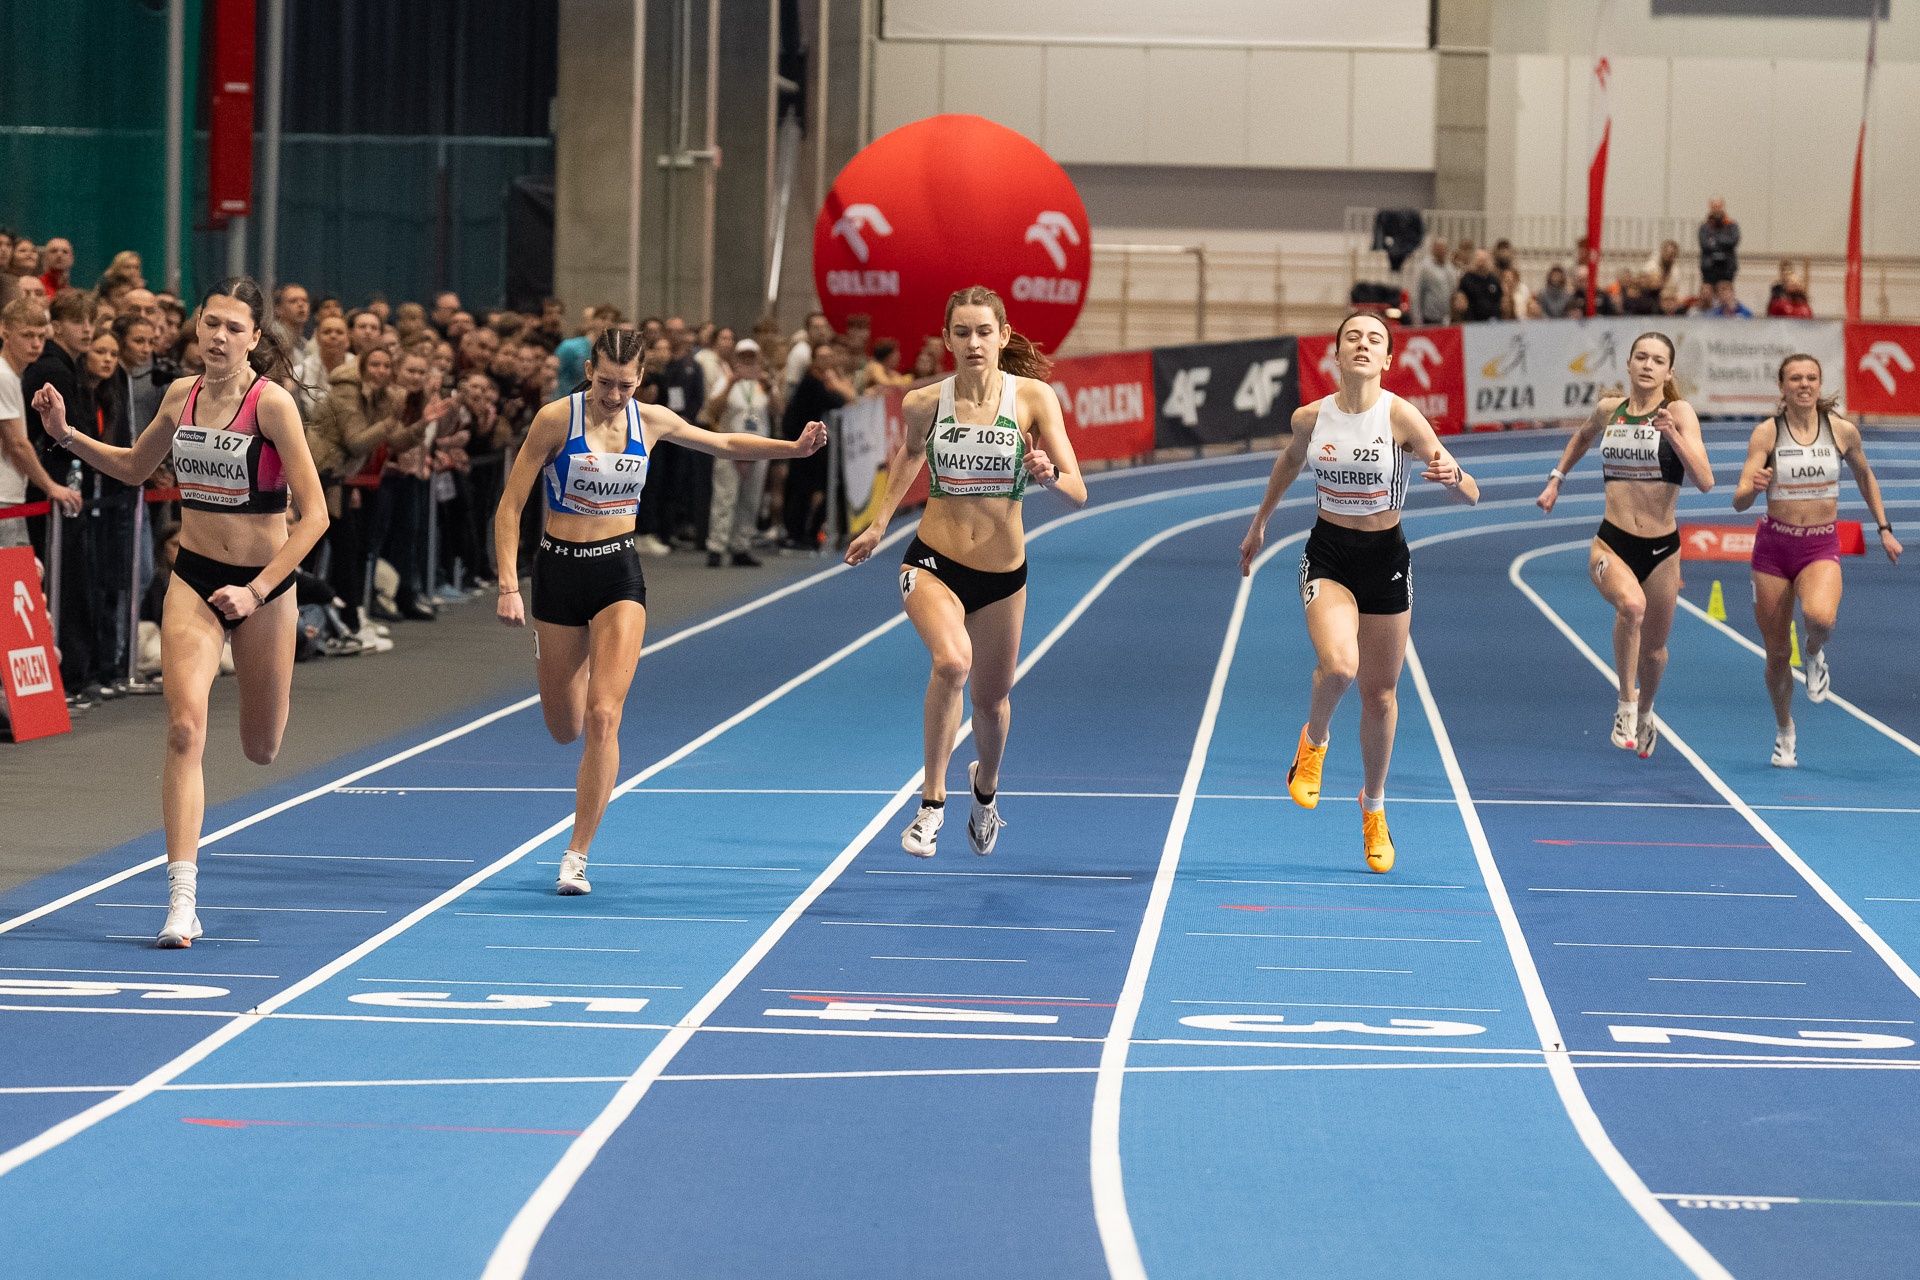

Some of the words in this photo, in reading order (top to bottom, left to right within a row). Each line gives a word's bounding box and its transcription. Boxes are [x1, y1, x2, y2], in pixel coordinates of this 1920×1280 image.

[826, 269, 900, 296] ORLEN
[1162, 366, 1212, 426] 4F
[1234, 357, 1290, 418] 4F
[1075, 382, 1145, 428] ORLEN
[1475, 384, 1535, 411] DZLA
[939, 426, 971, 444] 4F
[976, 430, 1015, 447] 1033
[1633, 429, 1655, 440] 612
[213, 435, 244, 452] 167
[1353, 448, 1379, 462] 925
[1602, 447, 1656, 461] GRUCHLIK
[1811, 448, 1831, 457] 188
[175, 456, 246, 480] KORNACKA
[615, 458, 641, 473] 677
[937, 452, 1012, 471] MAŁYSZEK
[1315, 468, 1384, 486] PASIERBEK
[1791, 466, 1826, 478] LADA
[573, 479, 639, 496] GAWLIK
[220, 496, 238, 504] 2025
[1771, 522, 1805, 537] NIKE
[1806, 524, 1835, 537] PRO
[573, 542, 621, 558] UNDER
[903, 571, 911, 593] 4
[1305, 585, 1315, 605] 3
[14, 654, 48, 687] ORLEN
